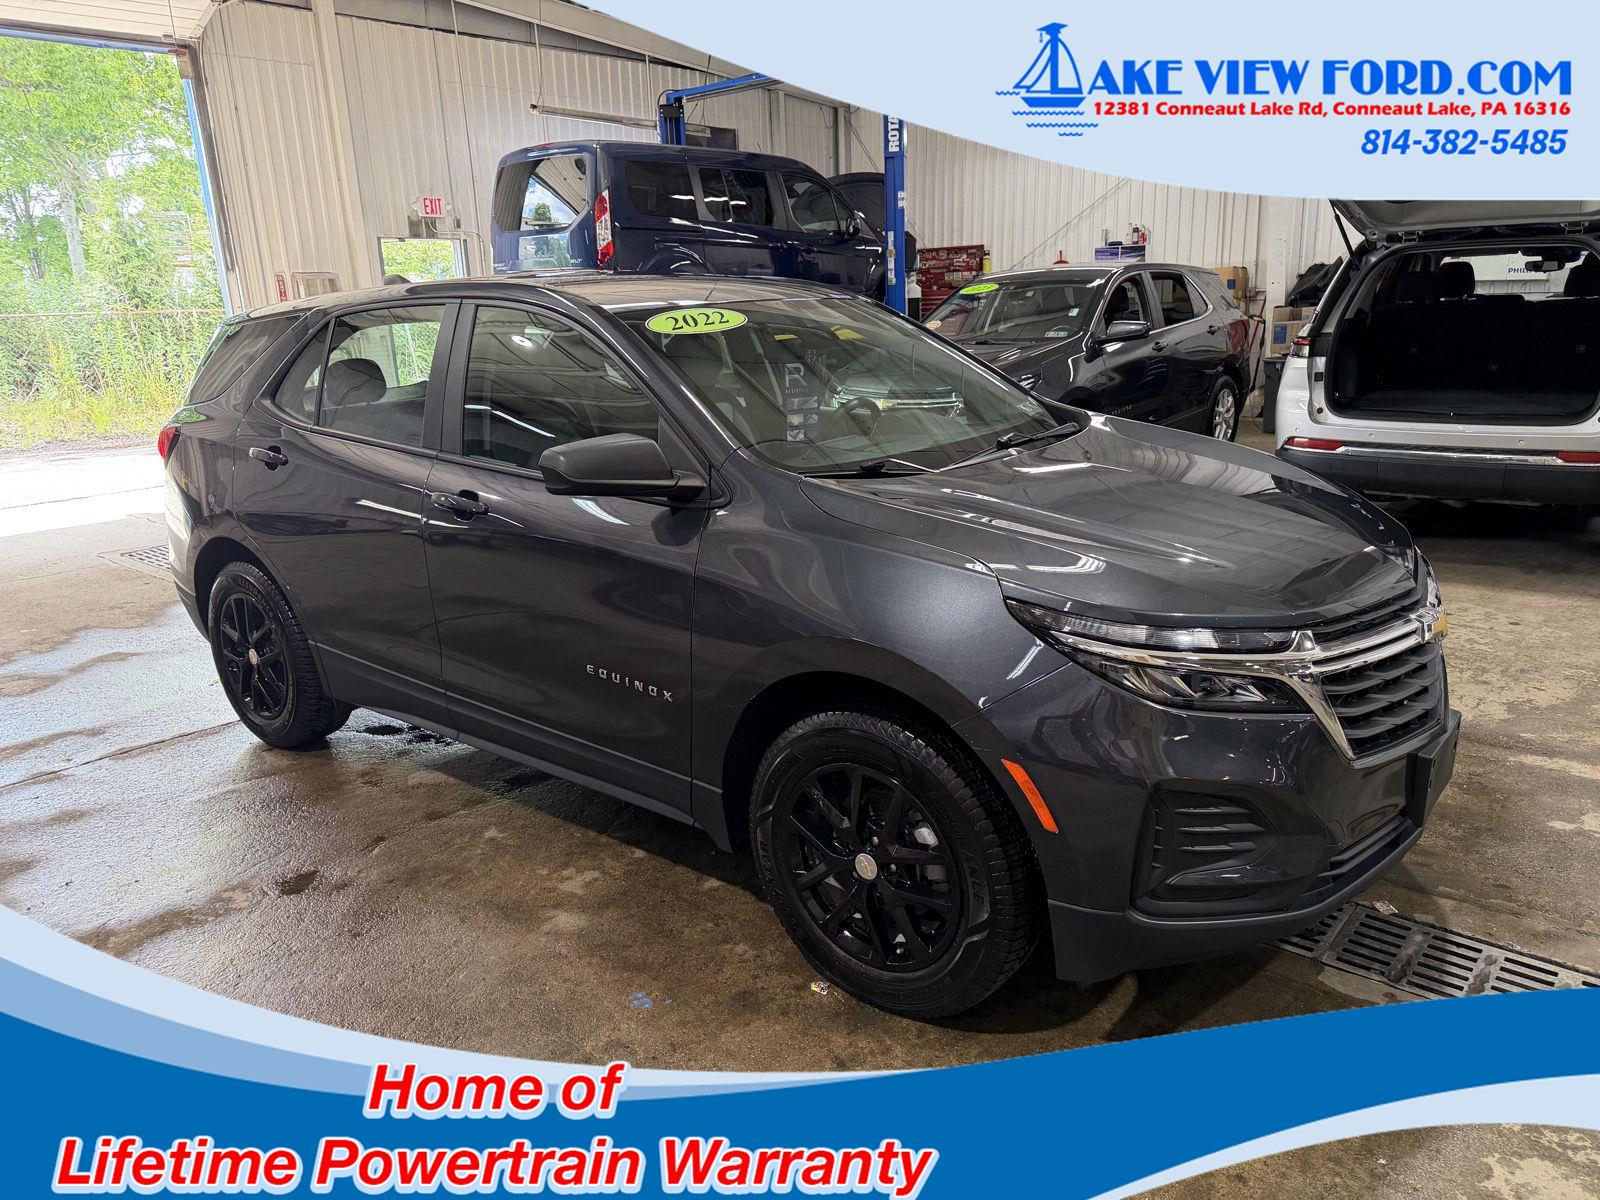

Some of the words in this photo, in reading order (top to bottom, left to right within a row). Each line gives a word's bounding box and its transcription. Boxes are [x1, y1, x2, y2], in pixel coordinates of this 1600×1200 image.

[422, 197, 443, 215] EXIT
[665, 311, 730, 331] 2022
[586, 664, 673, 702] EQUINOX
